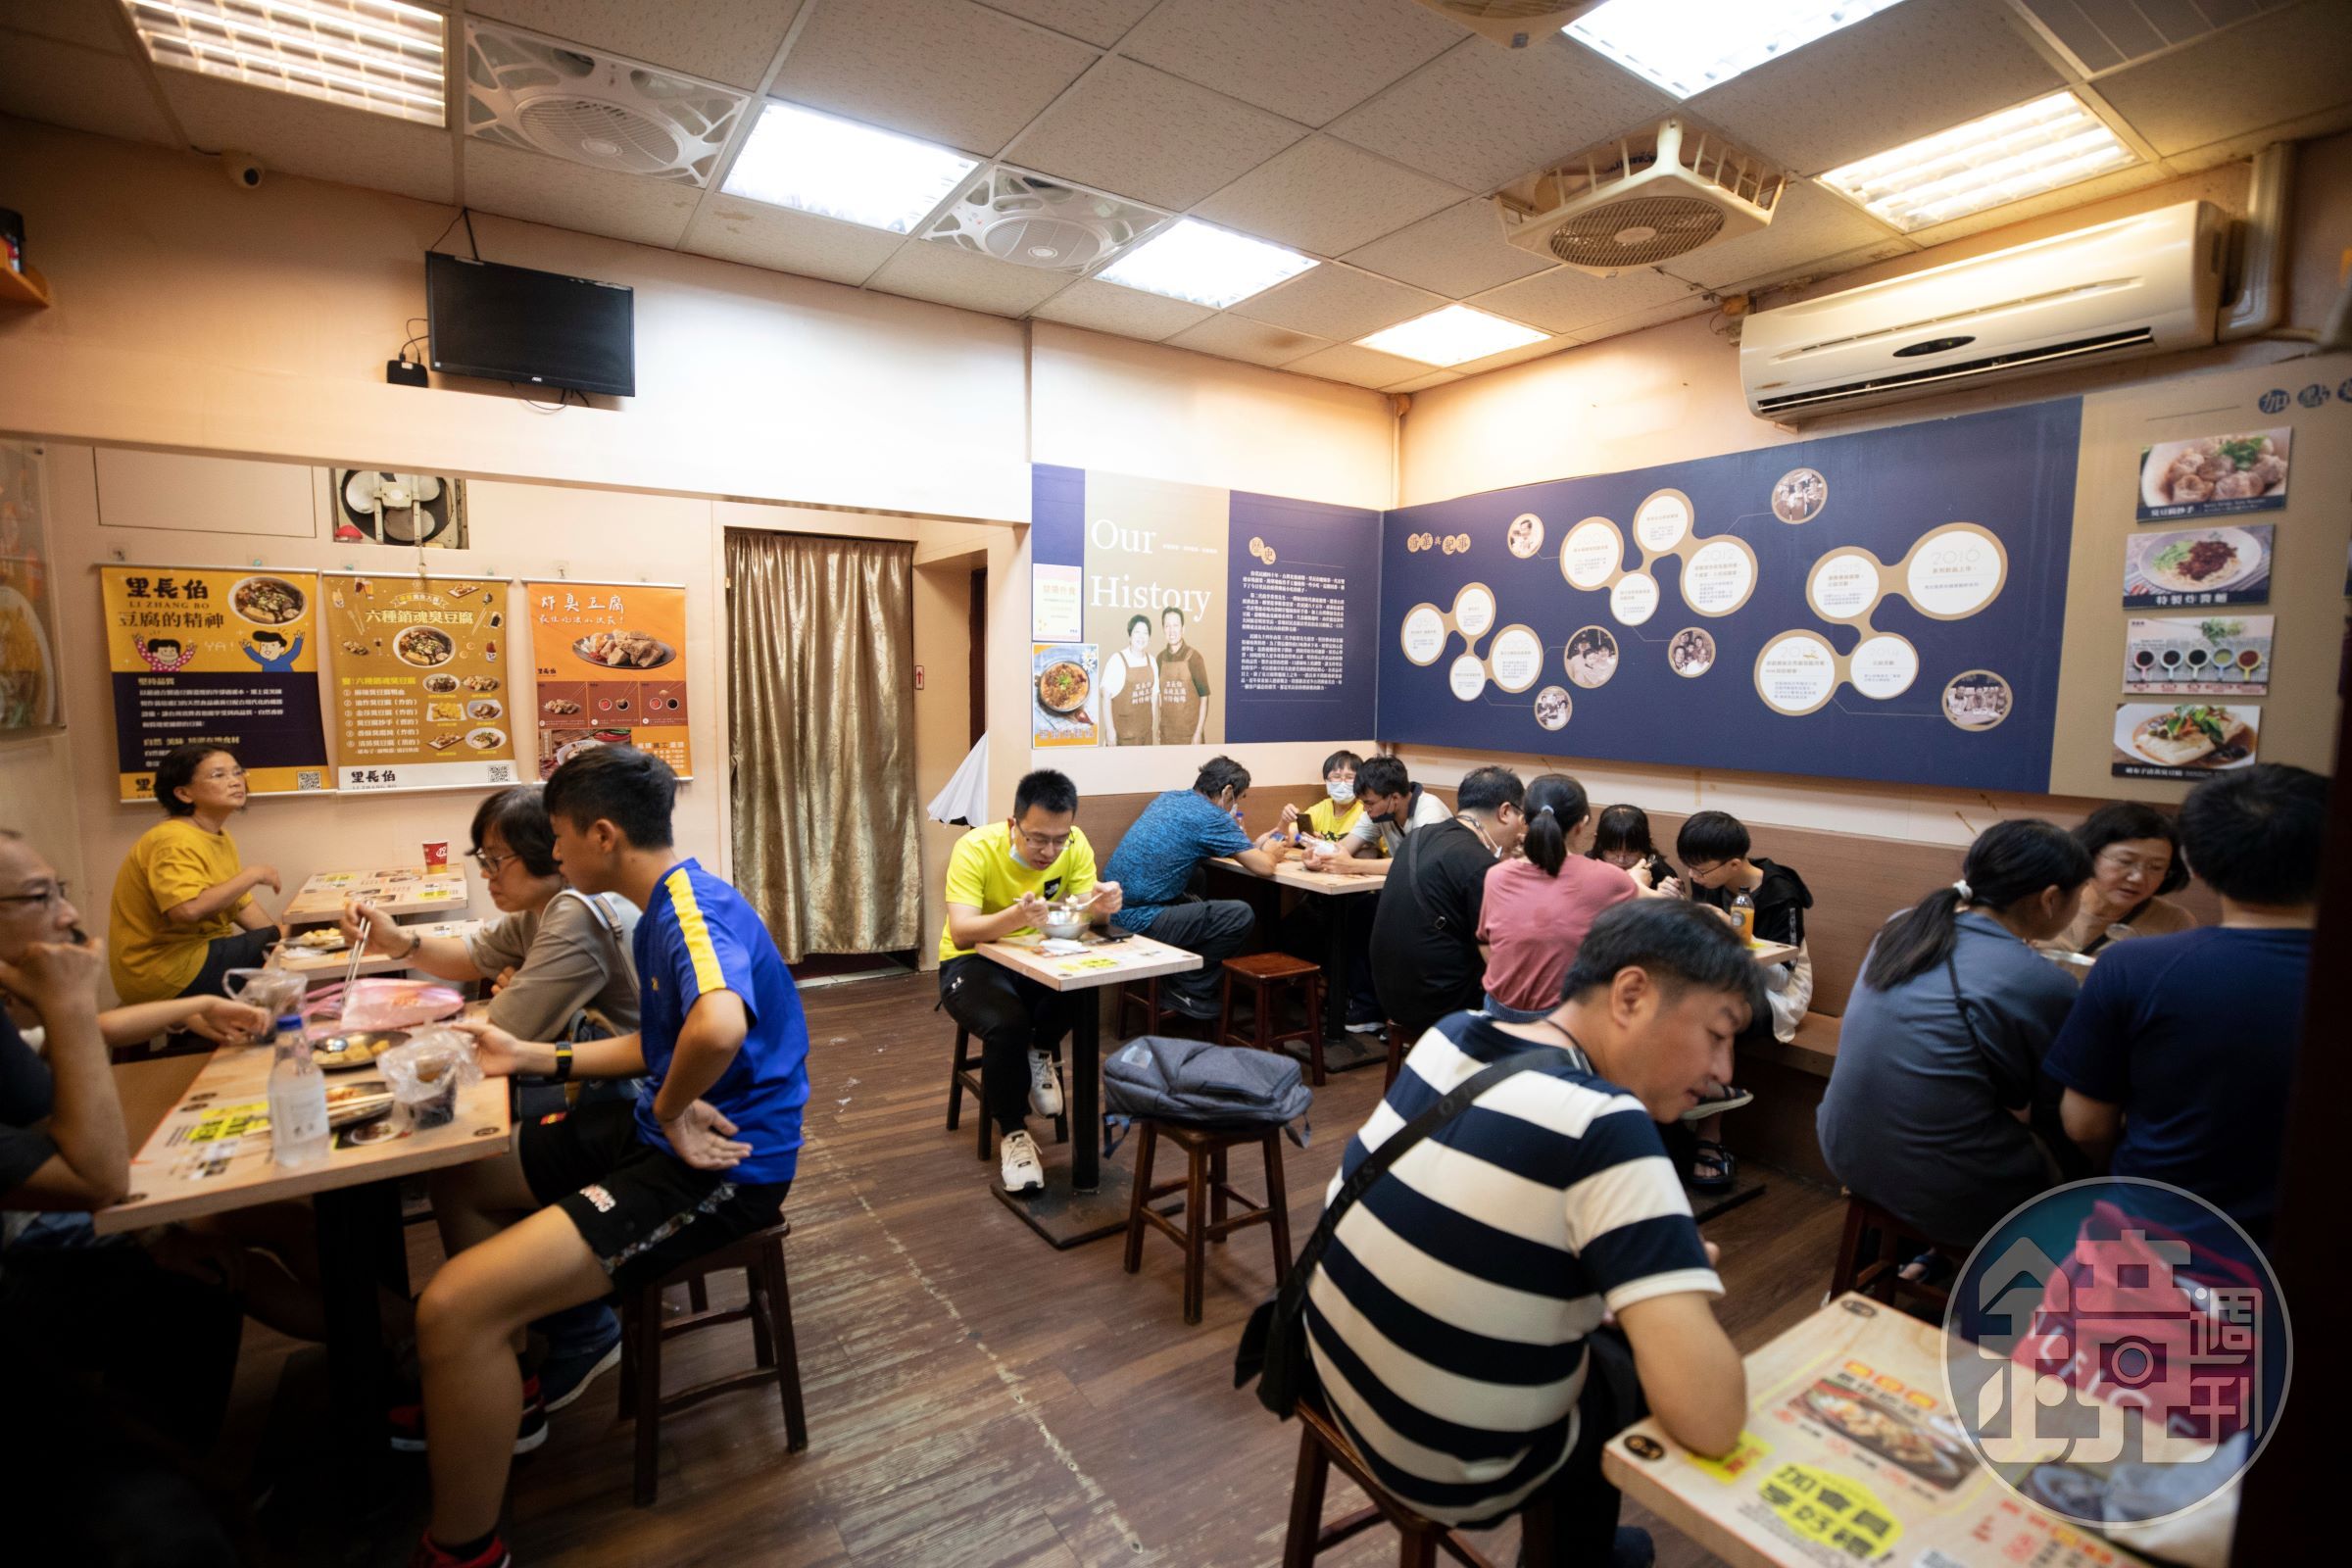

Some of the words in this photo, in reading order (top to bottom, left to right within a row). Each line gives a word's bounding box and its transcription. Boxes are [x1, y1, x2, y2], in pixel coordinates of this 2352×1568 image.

[1090, 519, 1156, 555] Our
[125, 577, 208, 600] 里長伯
[1090, 574, 1211, 622] History
[541, 593, 624, 613] 炸臭豆腐
[118, 612, 224, 628] 豆腐的精神
[366, 610, 473, 624] 六種銷魂臭豆腐
[351, 770, 396, 783] 里長伯
